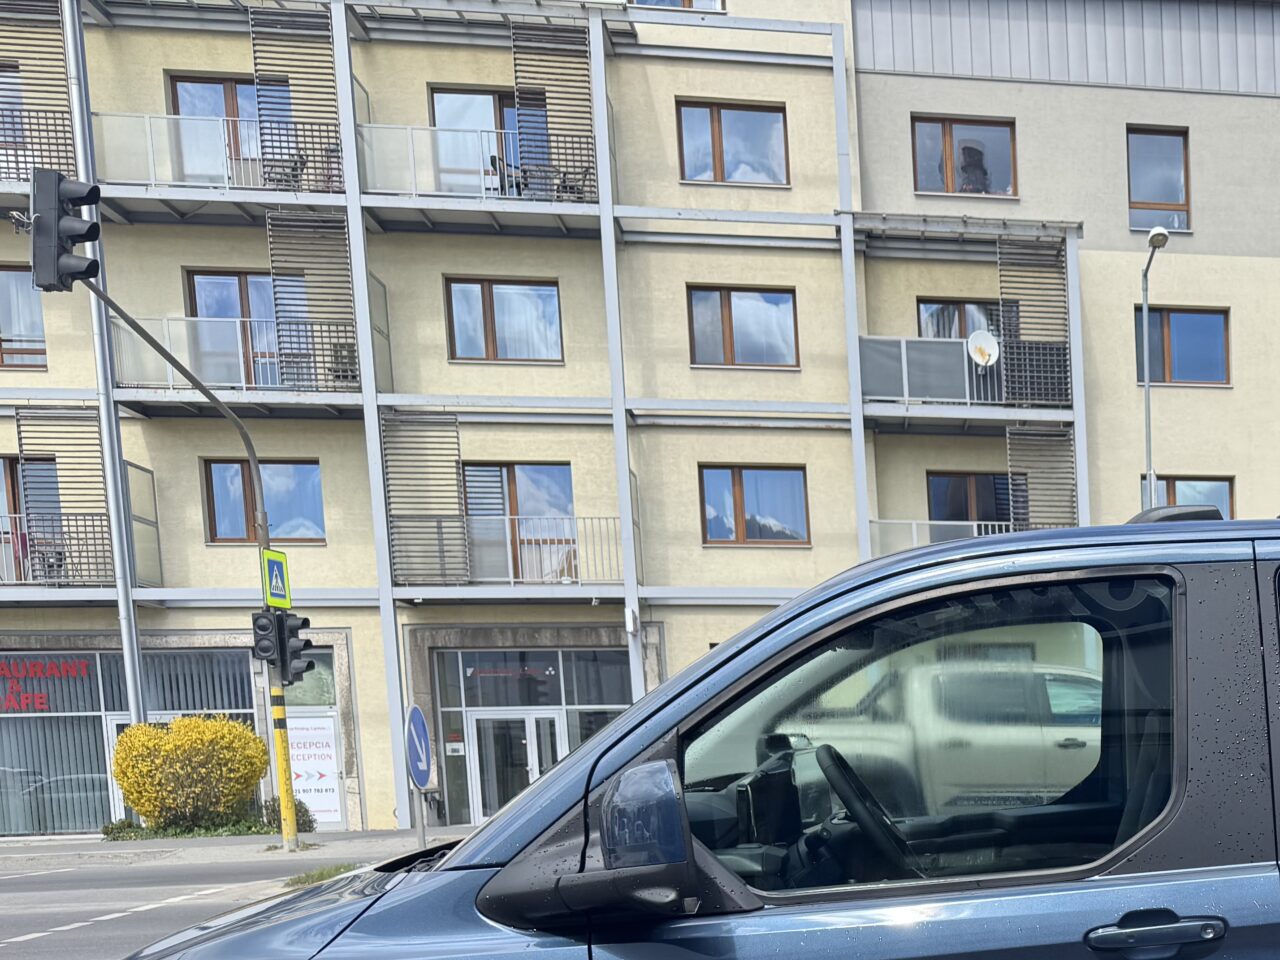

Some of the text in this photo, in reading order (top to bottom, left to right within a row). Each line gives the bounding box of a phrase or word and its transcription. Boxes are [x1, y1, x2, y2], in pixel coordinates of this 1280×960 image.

[0, 660, 88, 678] AURANT
[0, 693, 49, 710] AFE
[290, 741, 331, 750] ECEPCIA
[291, 753, 333, 761] ECEPTION
